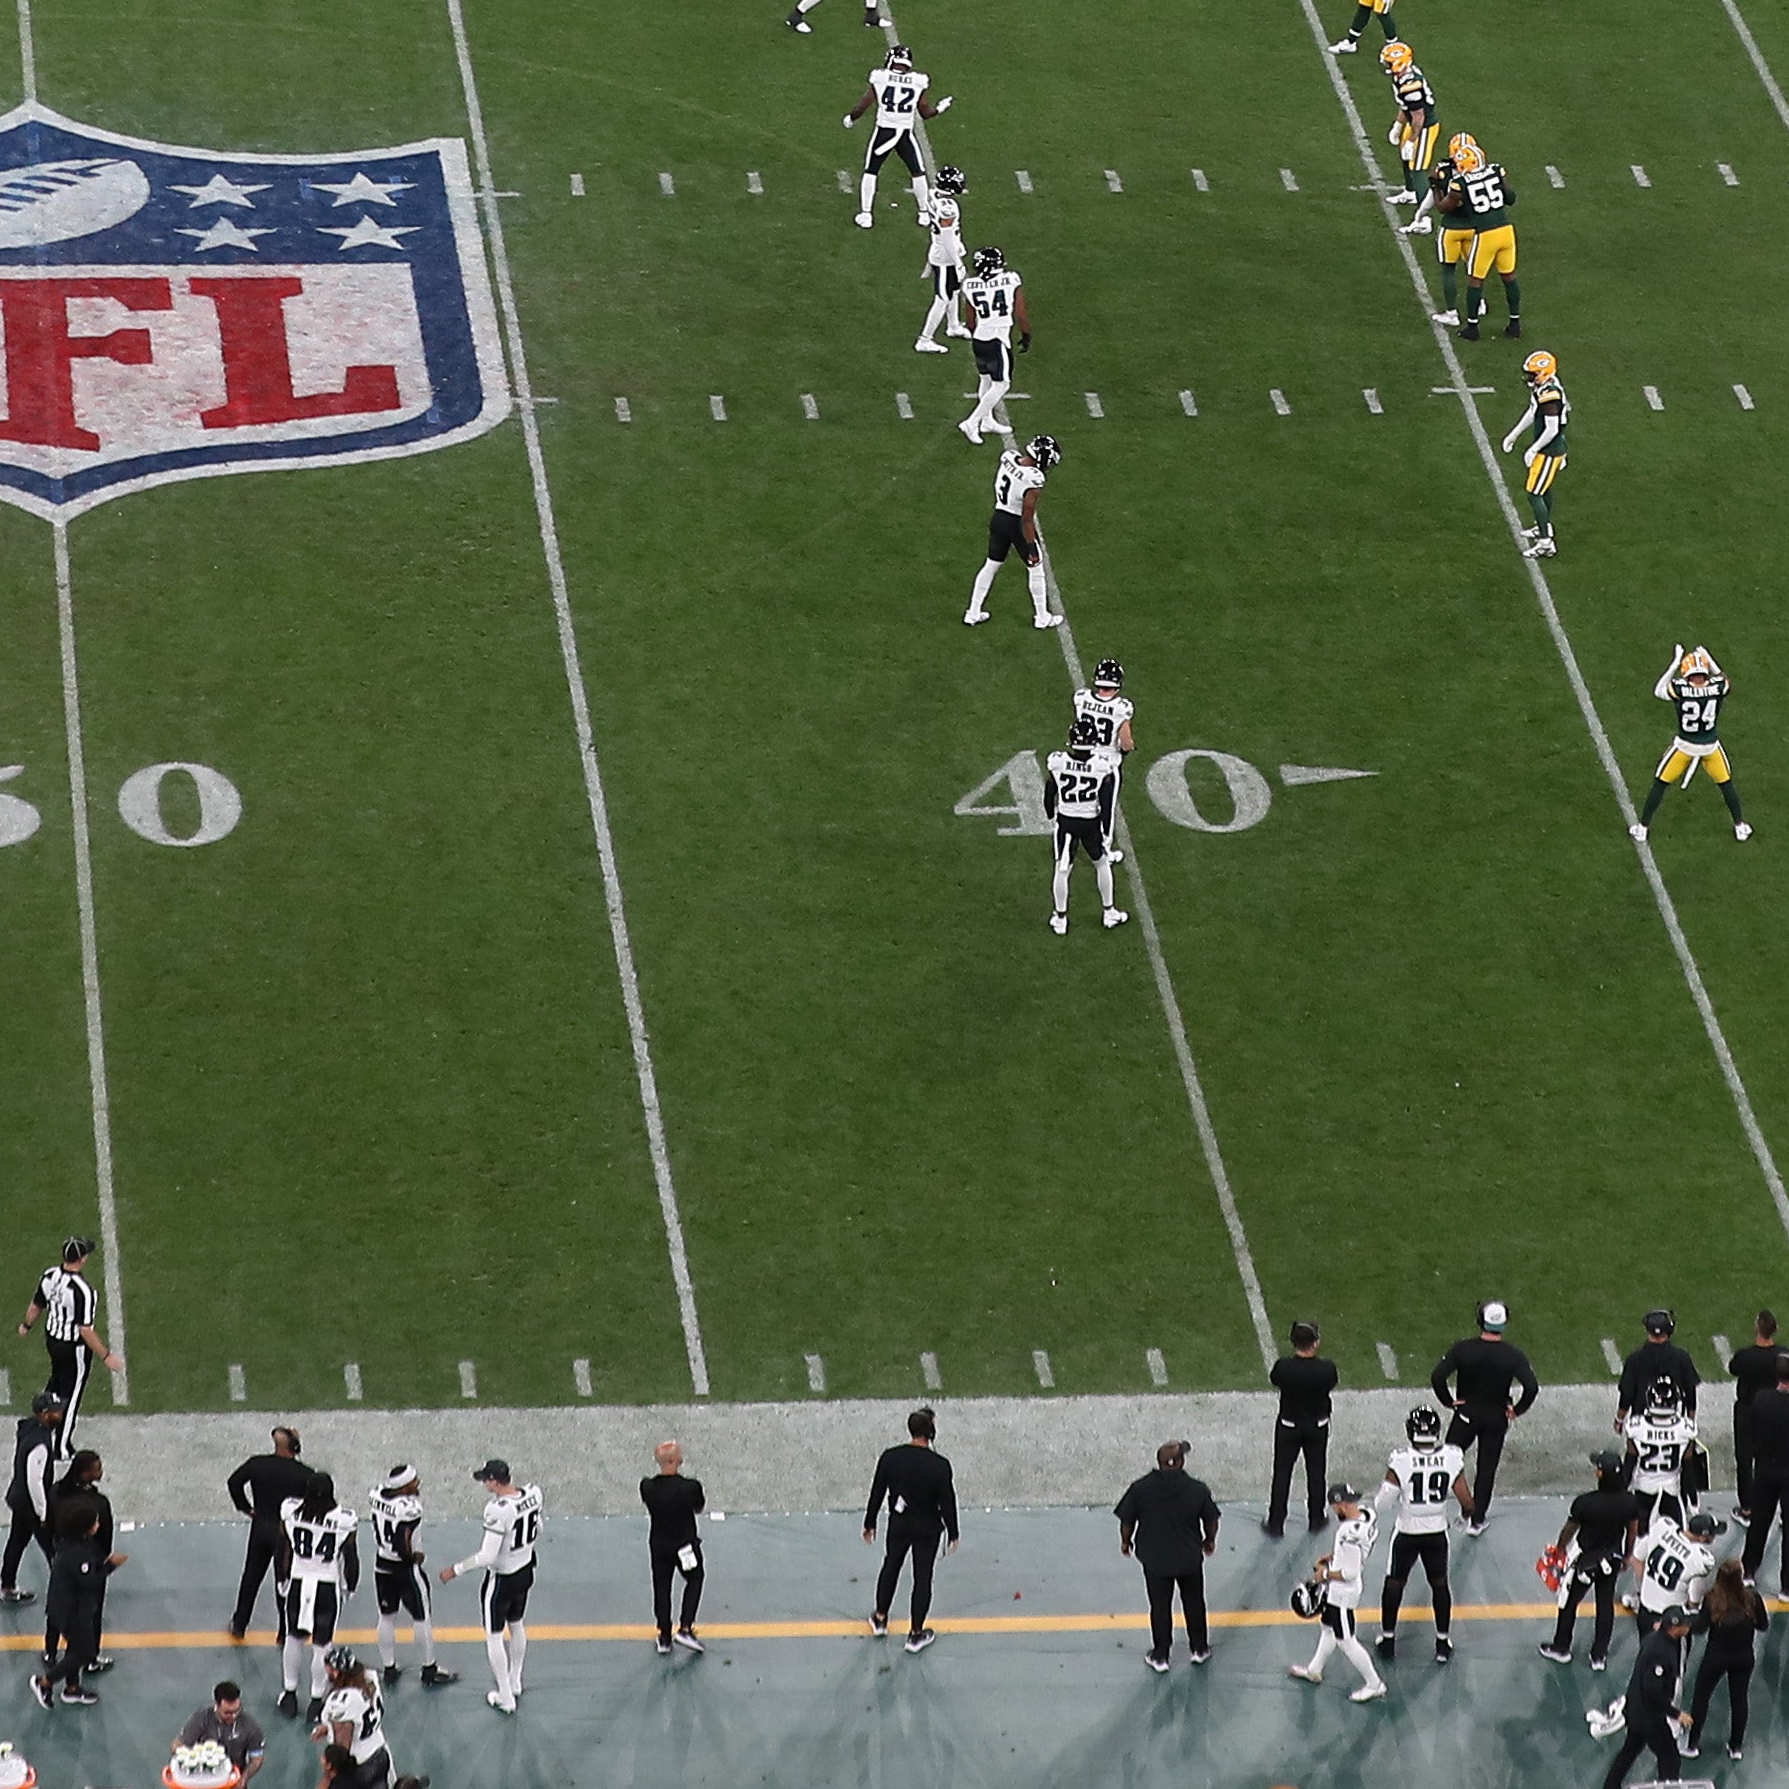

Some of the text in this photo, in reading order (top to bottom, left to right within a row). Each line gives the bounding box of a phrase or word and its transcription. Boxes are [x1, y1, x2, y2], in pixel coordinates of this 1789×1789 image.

[881, 86, 915, 113] 42
[1468, 176, 1504, 213] 55
[972, 290, 1009, 319] 54
[998, 474, 1012, 505] 3
[1681, 685, 1721, 700] VALENTINE
[1681, 700, 1717, 733] 24
[1065, 758, 1092, 772] RINGO
[953, 748, 1272, 836] 40
[1060, 773, 1098, 803] 22
[1646, 1428, 1676, 1442] RICKS
[1411, 1455, 1445, 1468] SWEAT
[1639, 1442, 1681, 1472] 23
[1408, 1470, 1451, 1505] 19
[294, 1526, 338, 1563] 84
[508, 1510, 541, 1552] 16
[1646, 1544, 1686, 1592] 49
